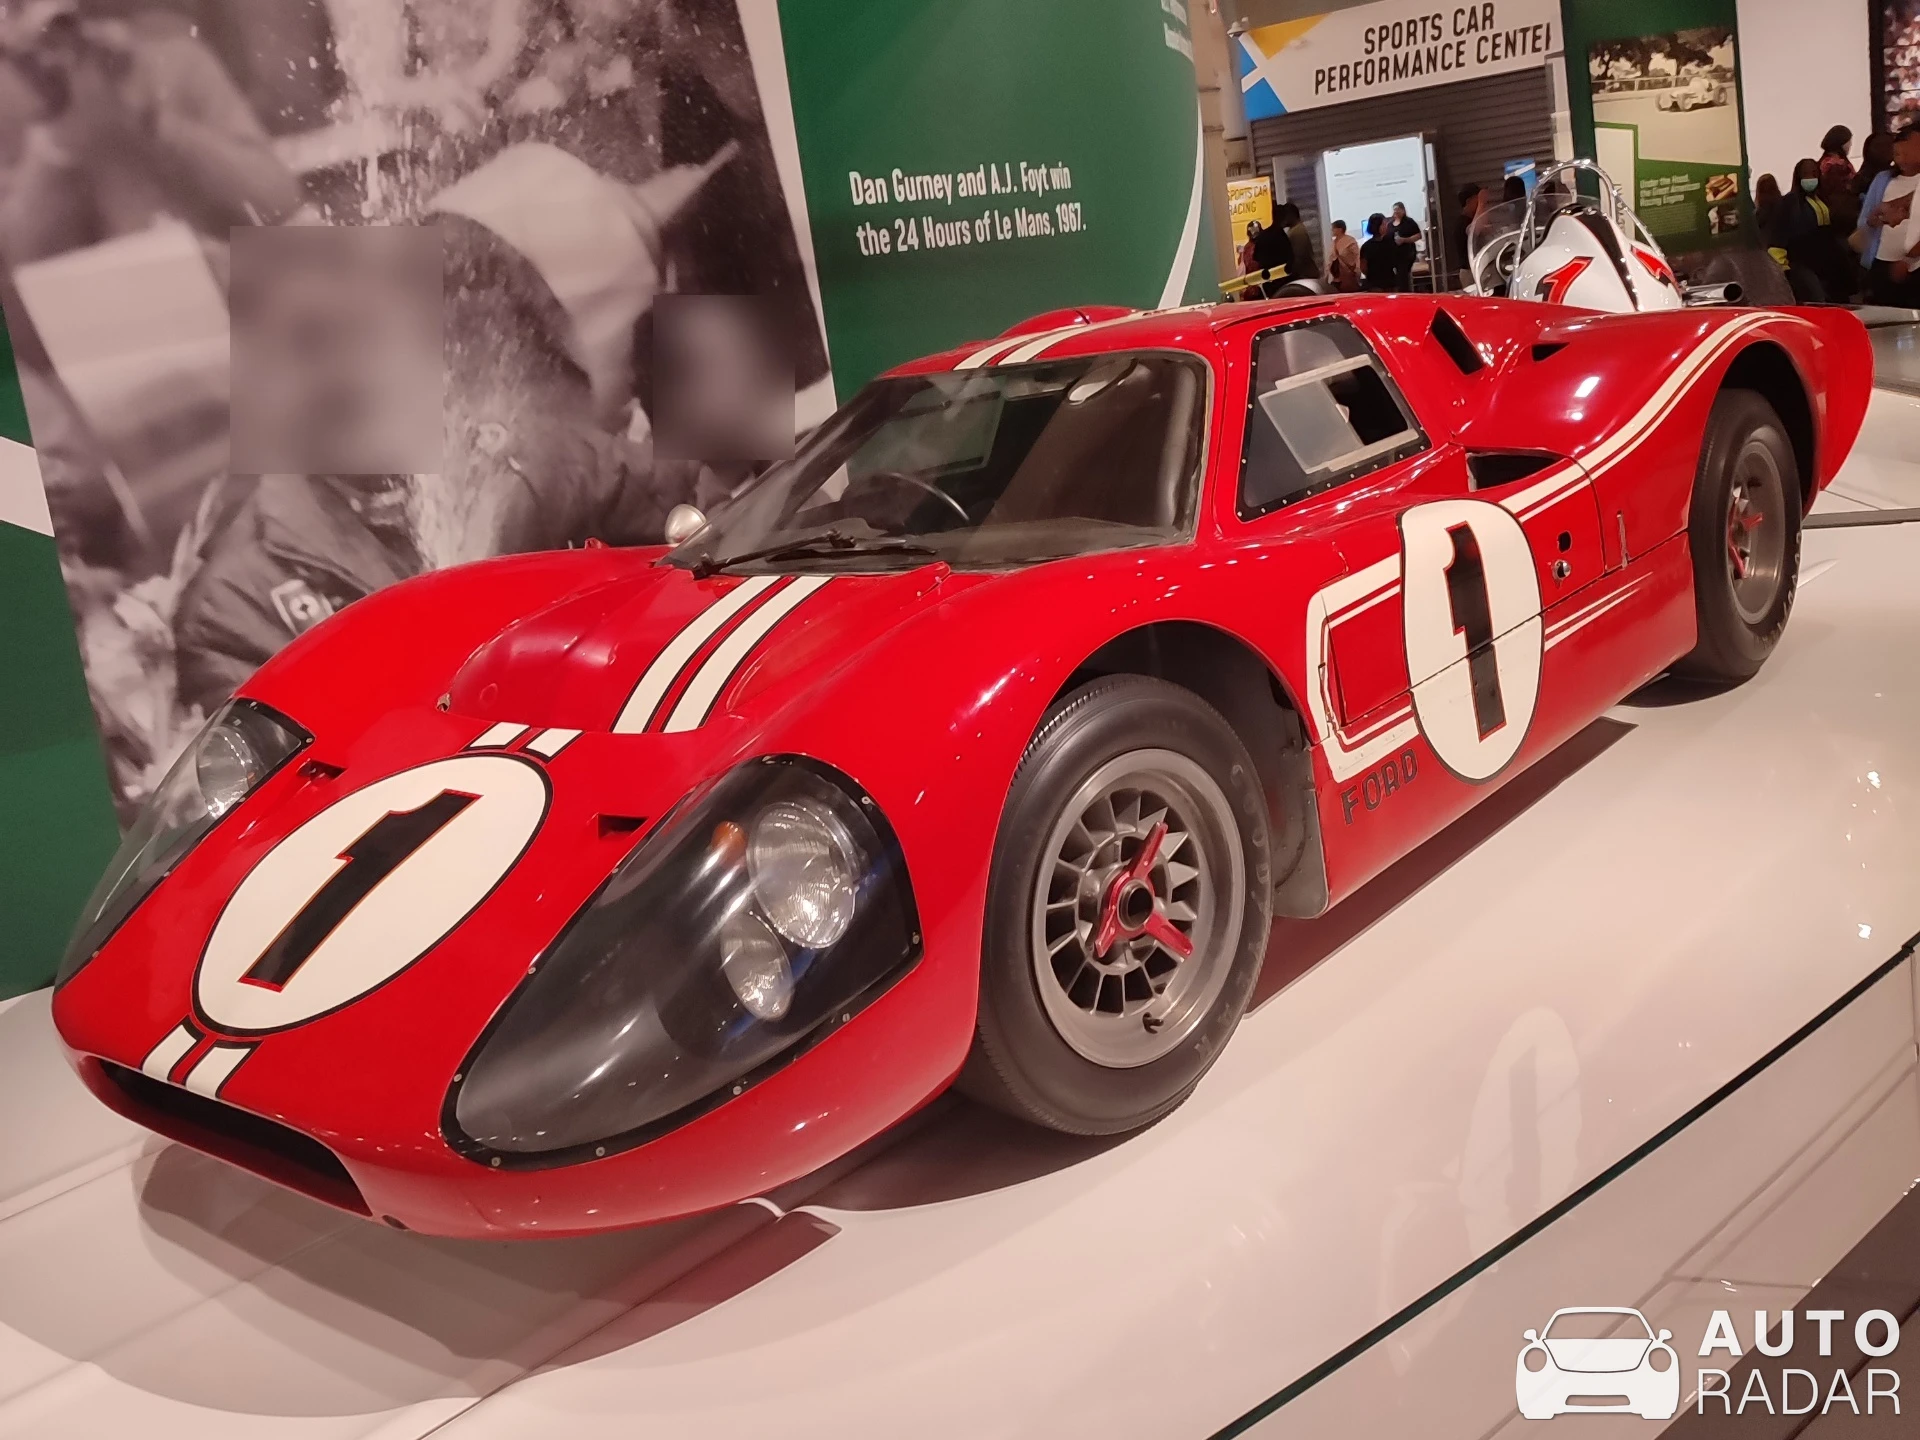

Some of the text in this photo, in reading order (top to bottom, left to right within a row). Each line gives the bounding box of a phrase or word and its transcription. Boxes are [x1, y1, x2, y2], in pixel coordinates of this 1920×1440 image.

[1364, 2, 1495, 55] SPORTS CAR
[1314, 40, 1467, 95] PERFORMANCE
[848, 161, 1072, 206] Dan Gurney and A.J. Foyt win
[1253, 184, 1269, 198] CAR
[856, 202, 1087, 256] the 24 Hours of Le Mans, 1967.
[1442, 520, 1507, 744] 1
[1340, 748, 1418, 826] FORD
[237, 787, 483, 993] 1
